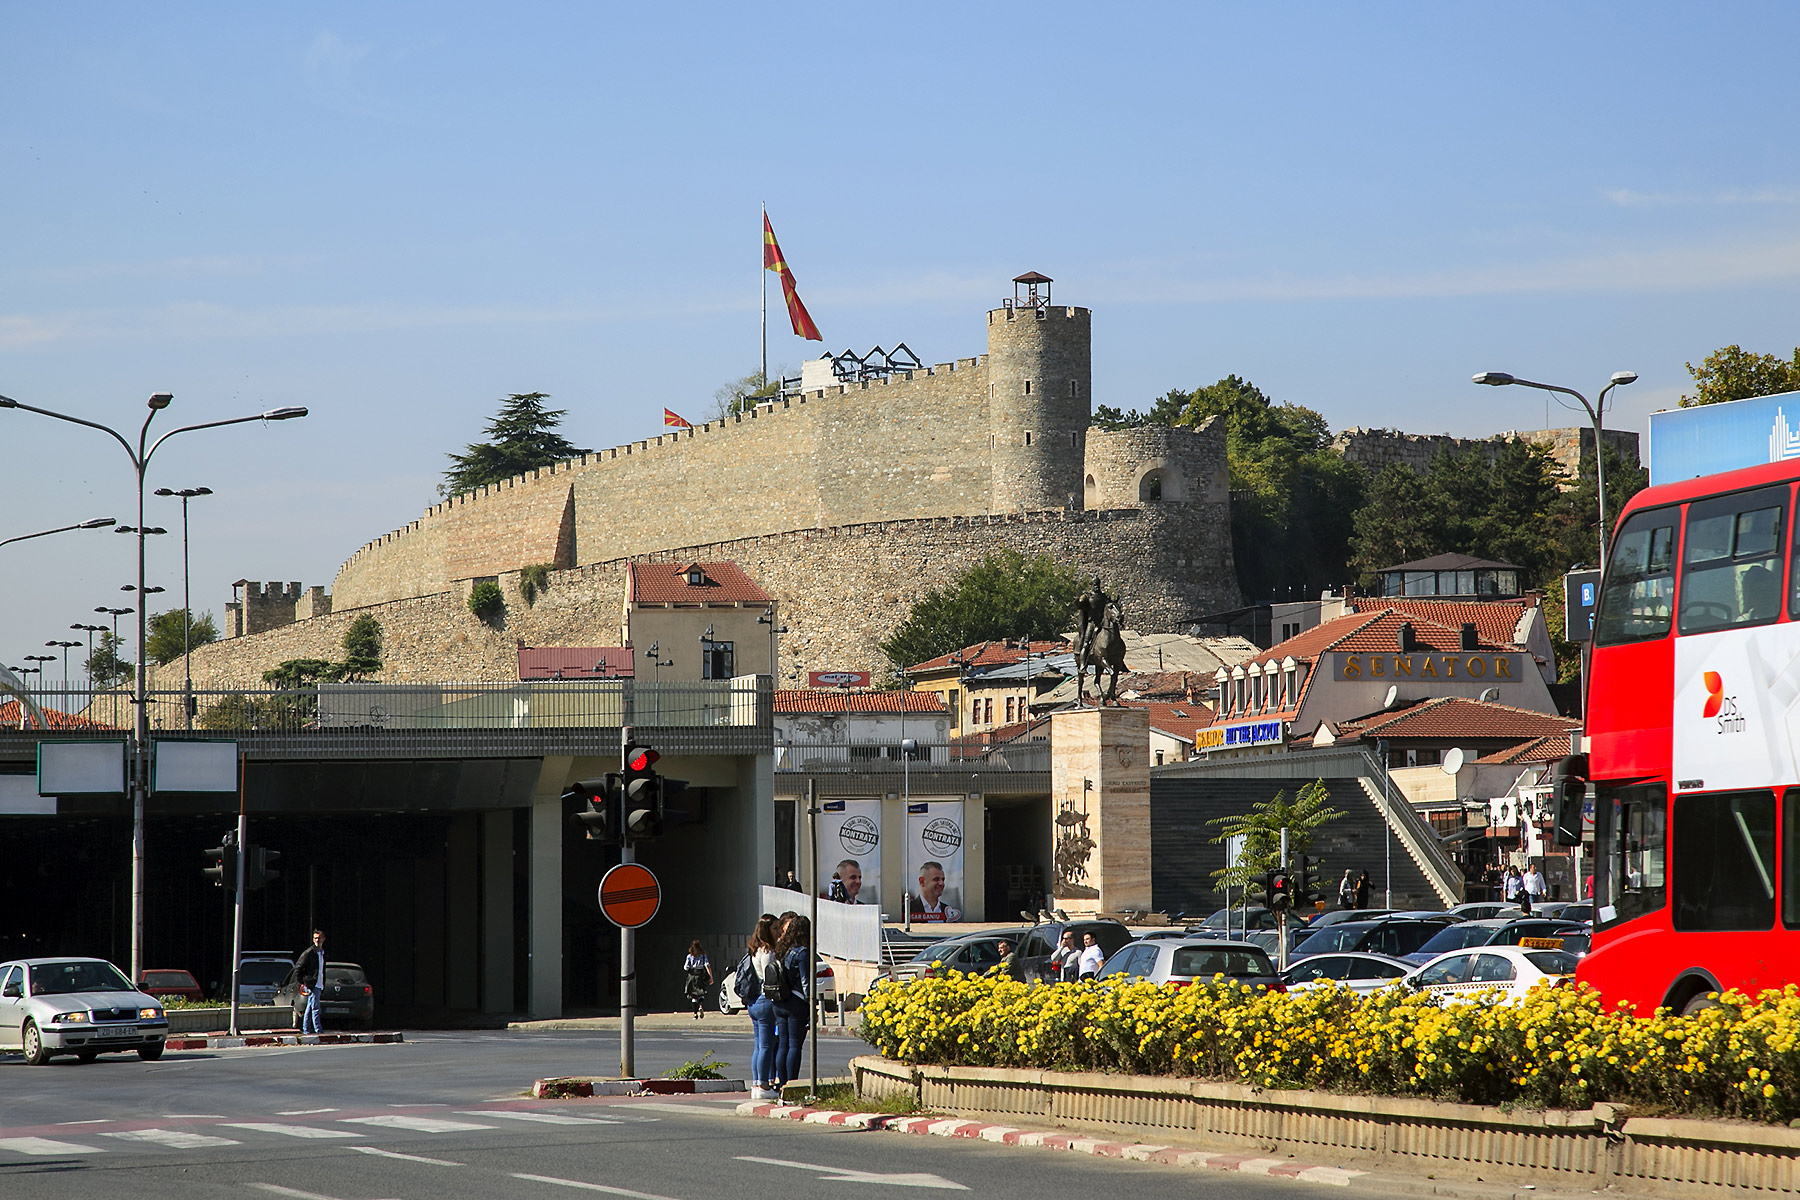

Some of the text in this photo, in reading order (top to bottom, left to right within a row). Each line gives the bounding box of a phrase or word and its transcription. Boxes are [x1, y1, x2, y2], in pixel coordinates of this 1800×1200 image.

[1343, 655, 1512, 679] SENATOR
[1724, 696, 1737, 716] DS
[1226, 726, 1238, 745] HIT
[1237, 725, 1251, 743] THE
[1250, 722, 1280, 745] JACKPOT
[1717, 712, 1746, 734] Smith
[841, 828, 877, 844] KONTRATA
[924, 830, 960, 846] KONTRATA
